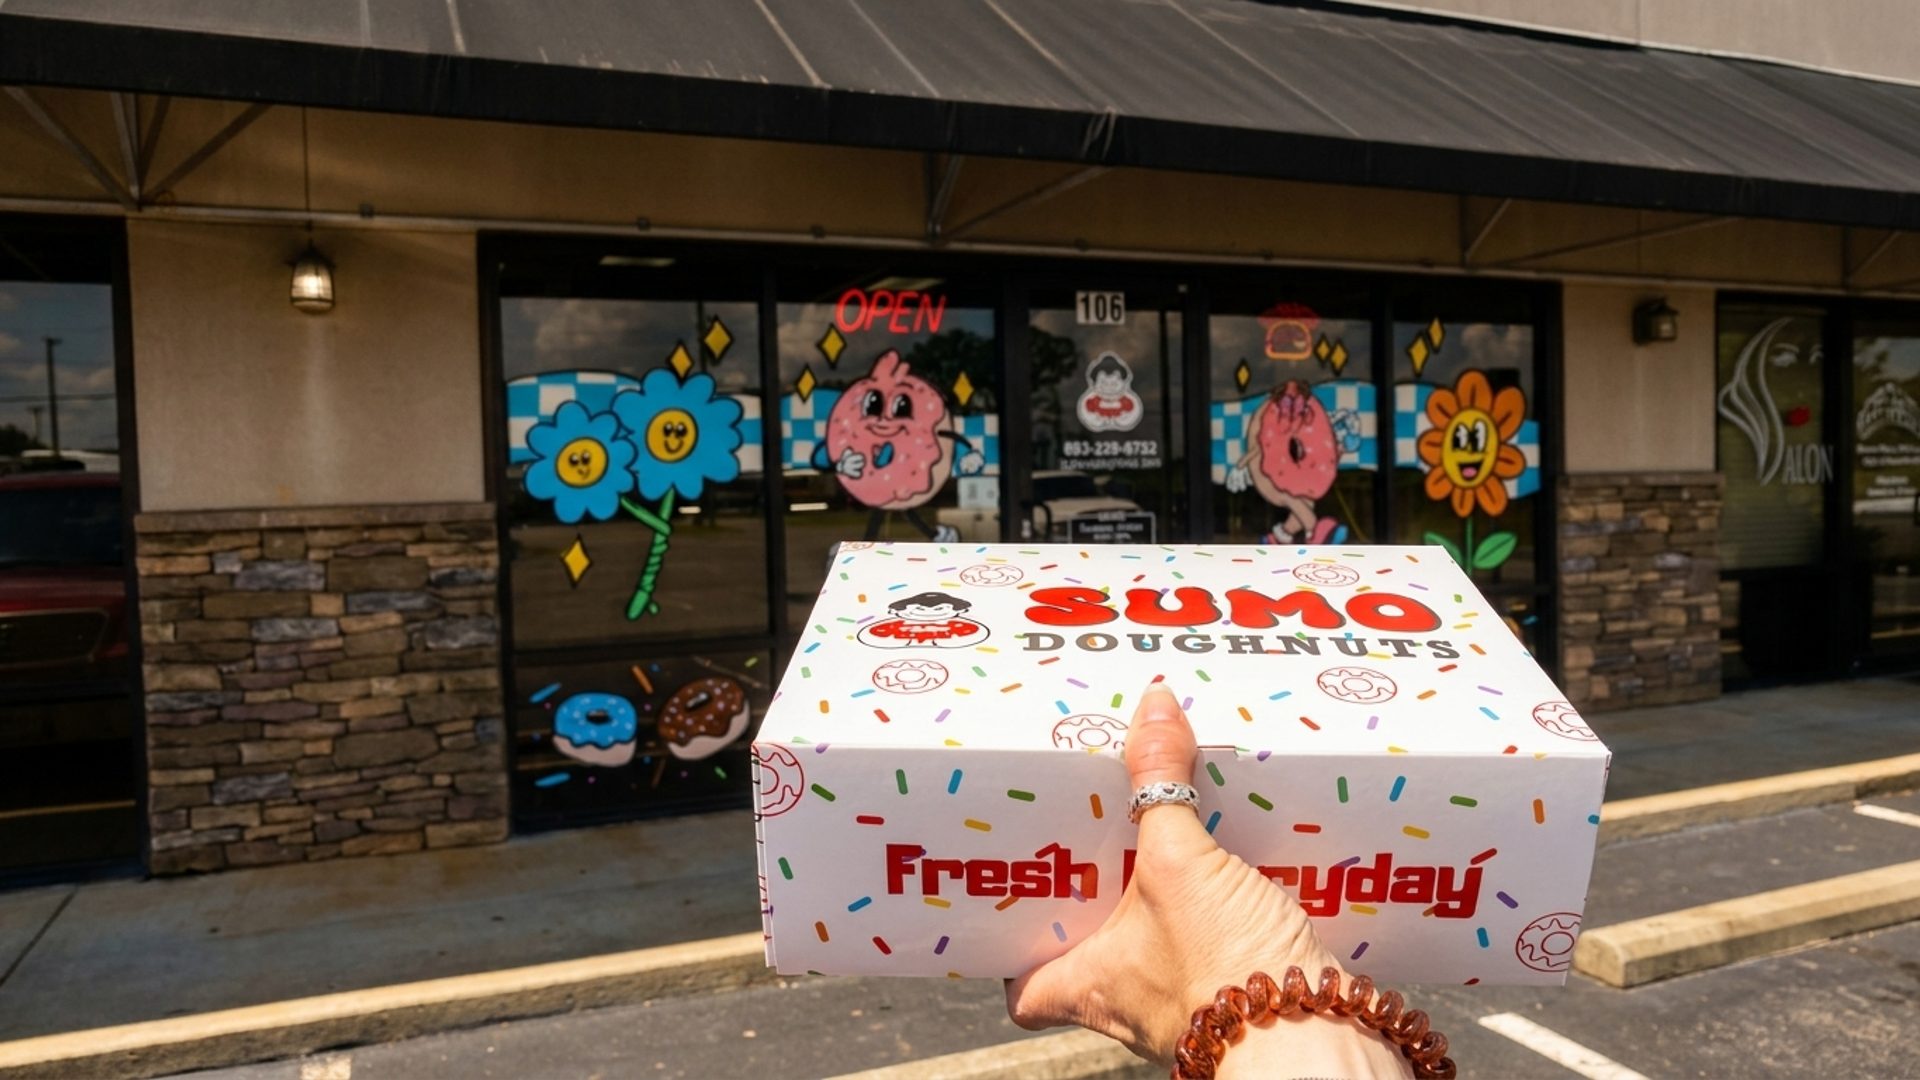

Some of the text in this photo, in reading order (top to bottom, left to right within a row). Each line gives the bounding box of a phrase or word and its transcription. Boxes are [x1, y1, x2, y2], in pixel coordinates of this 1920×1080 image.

[835, 288, 946, 333] OPEN
[1079, 294, 1122, 322] 106
[1024, 587, 1442, 632] SUMO
[1023, 632, 1460, 659] DOUGHNUTS
[886, 844, 1483, 919] Fresh ryday
